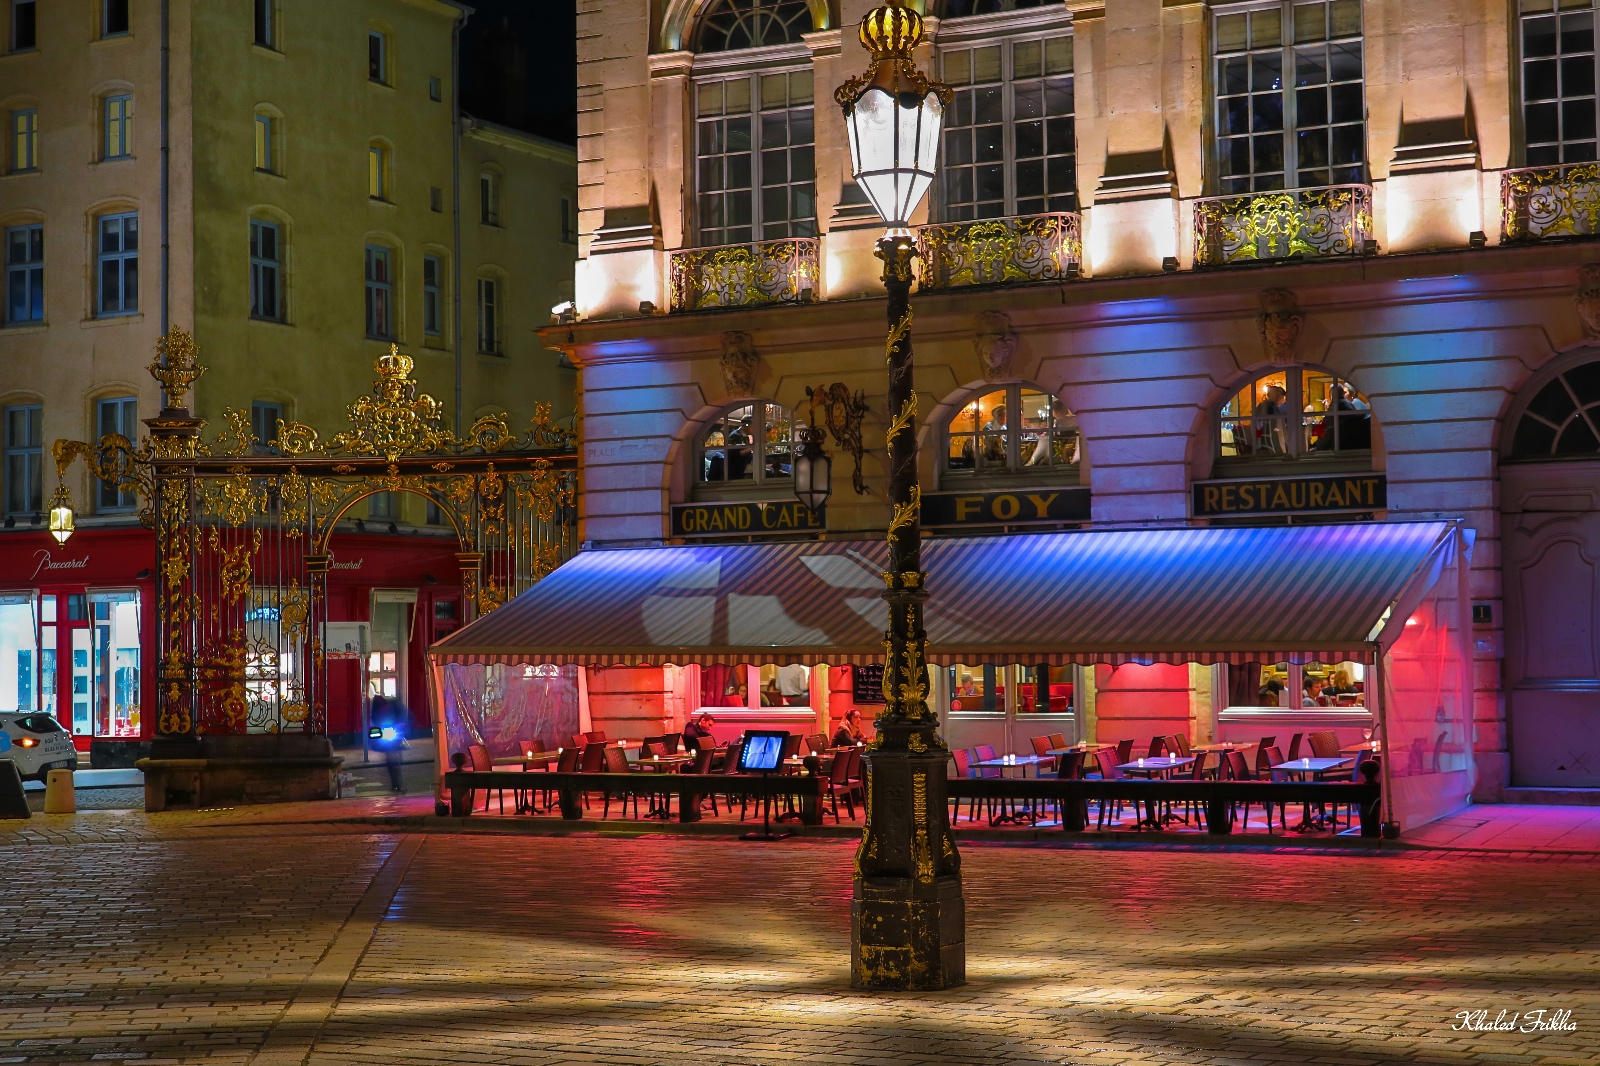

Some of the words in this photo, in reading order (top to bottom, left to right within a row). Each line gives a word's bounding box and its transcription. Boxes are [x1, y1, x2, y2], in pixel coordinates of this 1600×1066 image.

[955, 493, 1060, 521] FOY
[1203, 479, 1379, 512] RESTAURANT
[681, 506, 751, 532] GRAND
[30, 549, 90, 581] Baccarat
[326, 548, 363, 570] Baccarat
